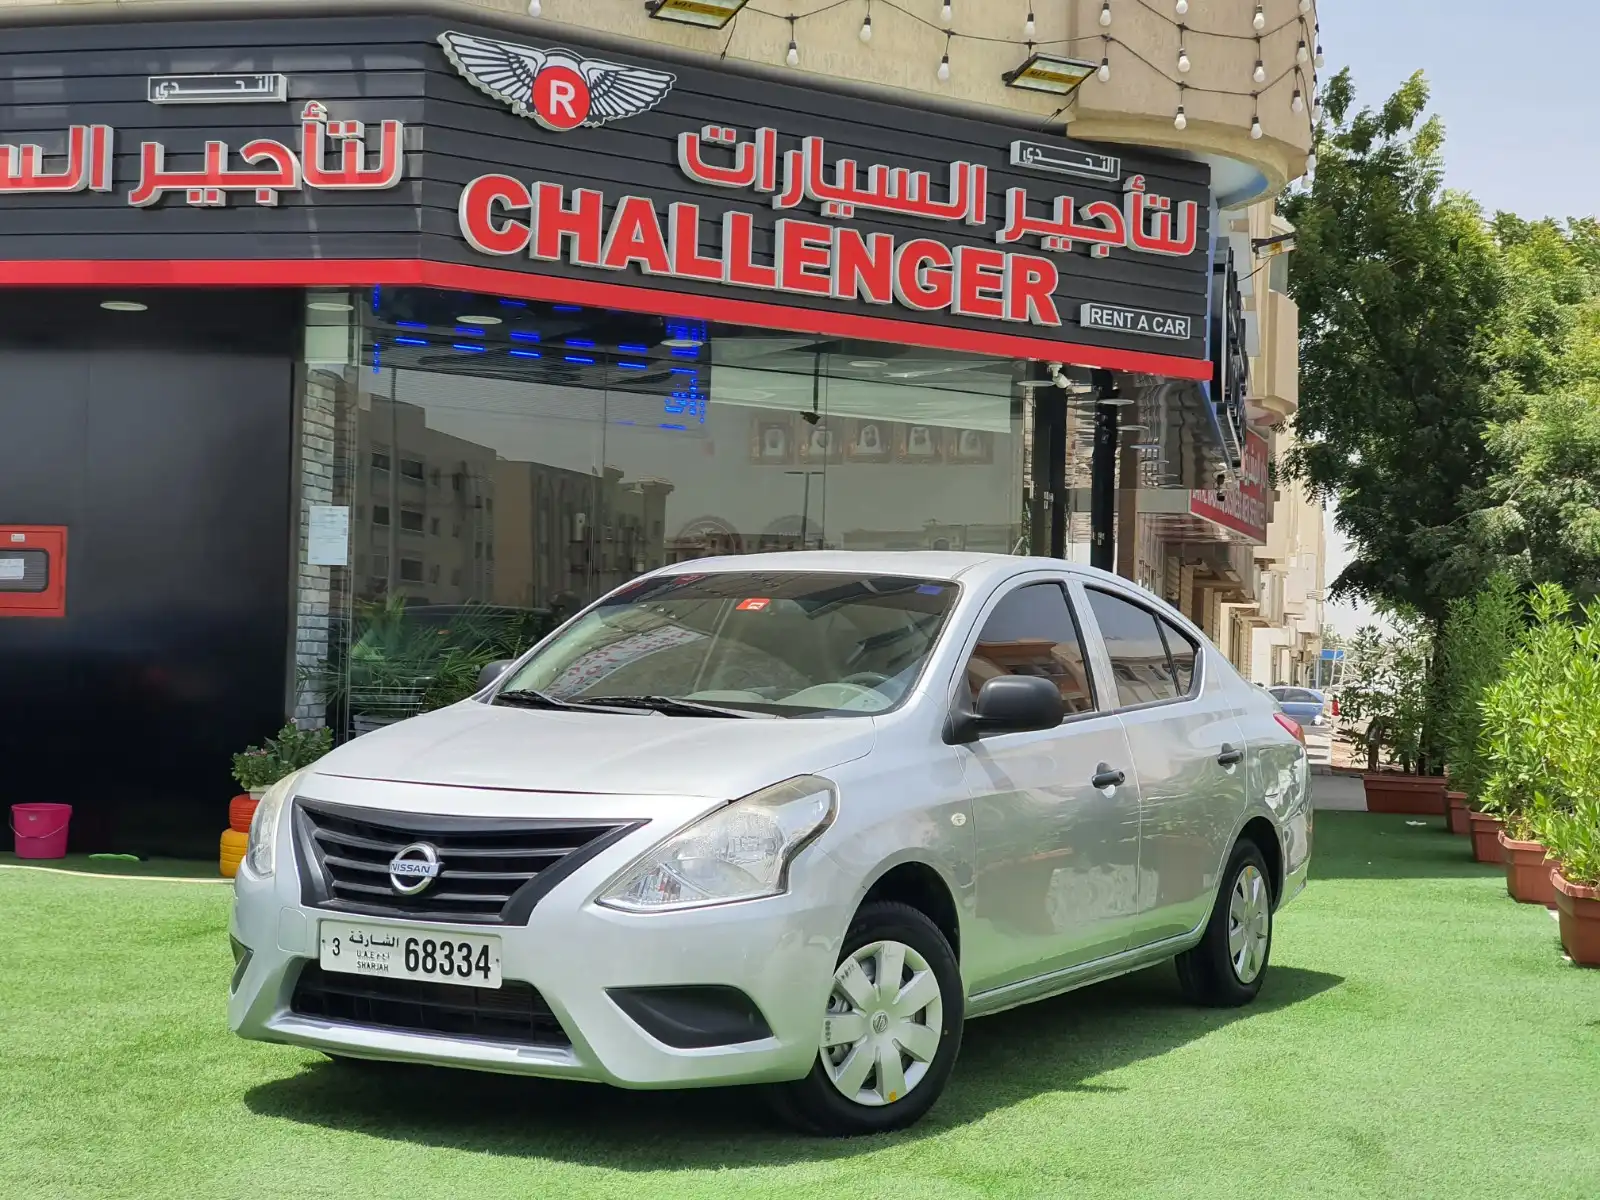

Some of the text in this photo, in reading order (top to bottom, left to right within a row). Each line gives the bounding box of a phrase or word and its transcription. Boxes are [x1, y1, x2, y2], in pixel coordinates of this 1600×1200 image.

[155, 75, 274, 100] التحدي
[549, 79, 577, 119] R
[128, 101, 403, 207] لتأجير
[677, 125, 1198, 258] لتأجير السيارات
[459, 173, 1062, 327] CHALLENGER
[1090, 307, 1187, 336] RENT A CAR
[390, 863, 431, 874] NISSAN
[332, 937, 341, 957] 3
[348, 930, 400, 948] الشارقة
[356, 960, 389, 972] SHARJAH
[404, 937, 491, 980] 68334
